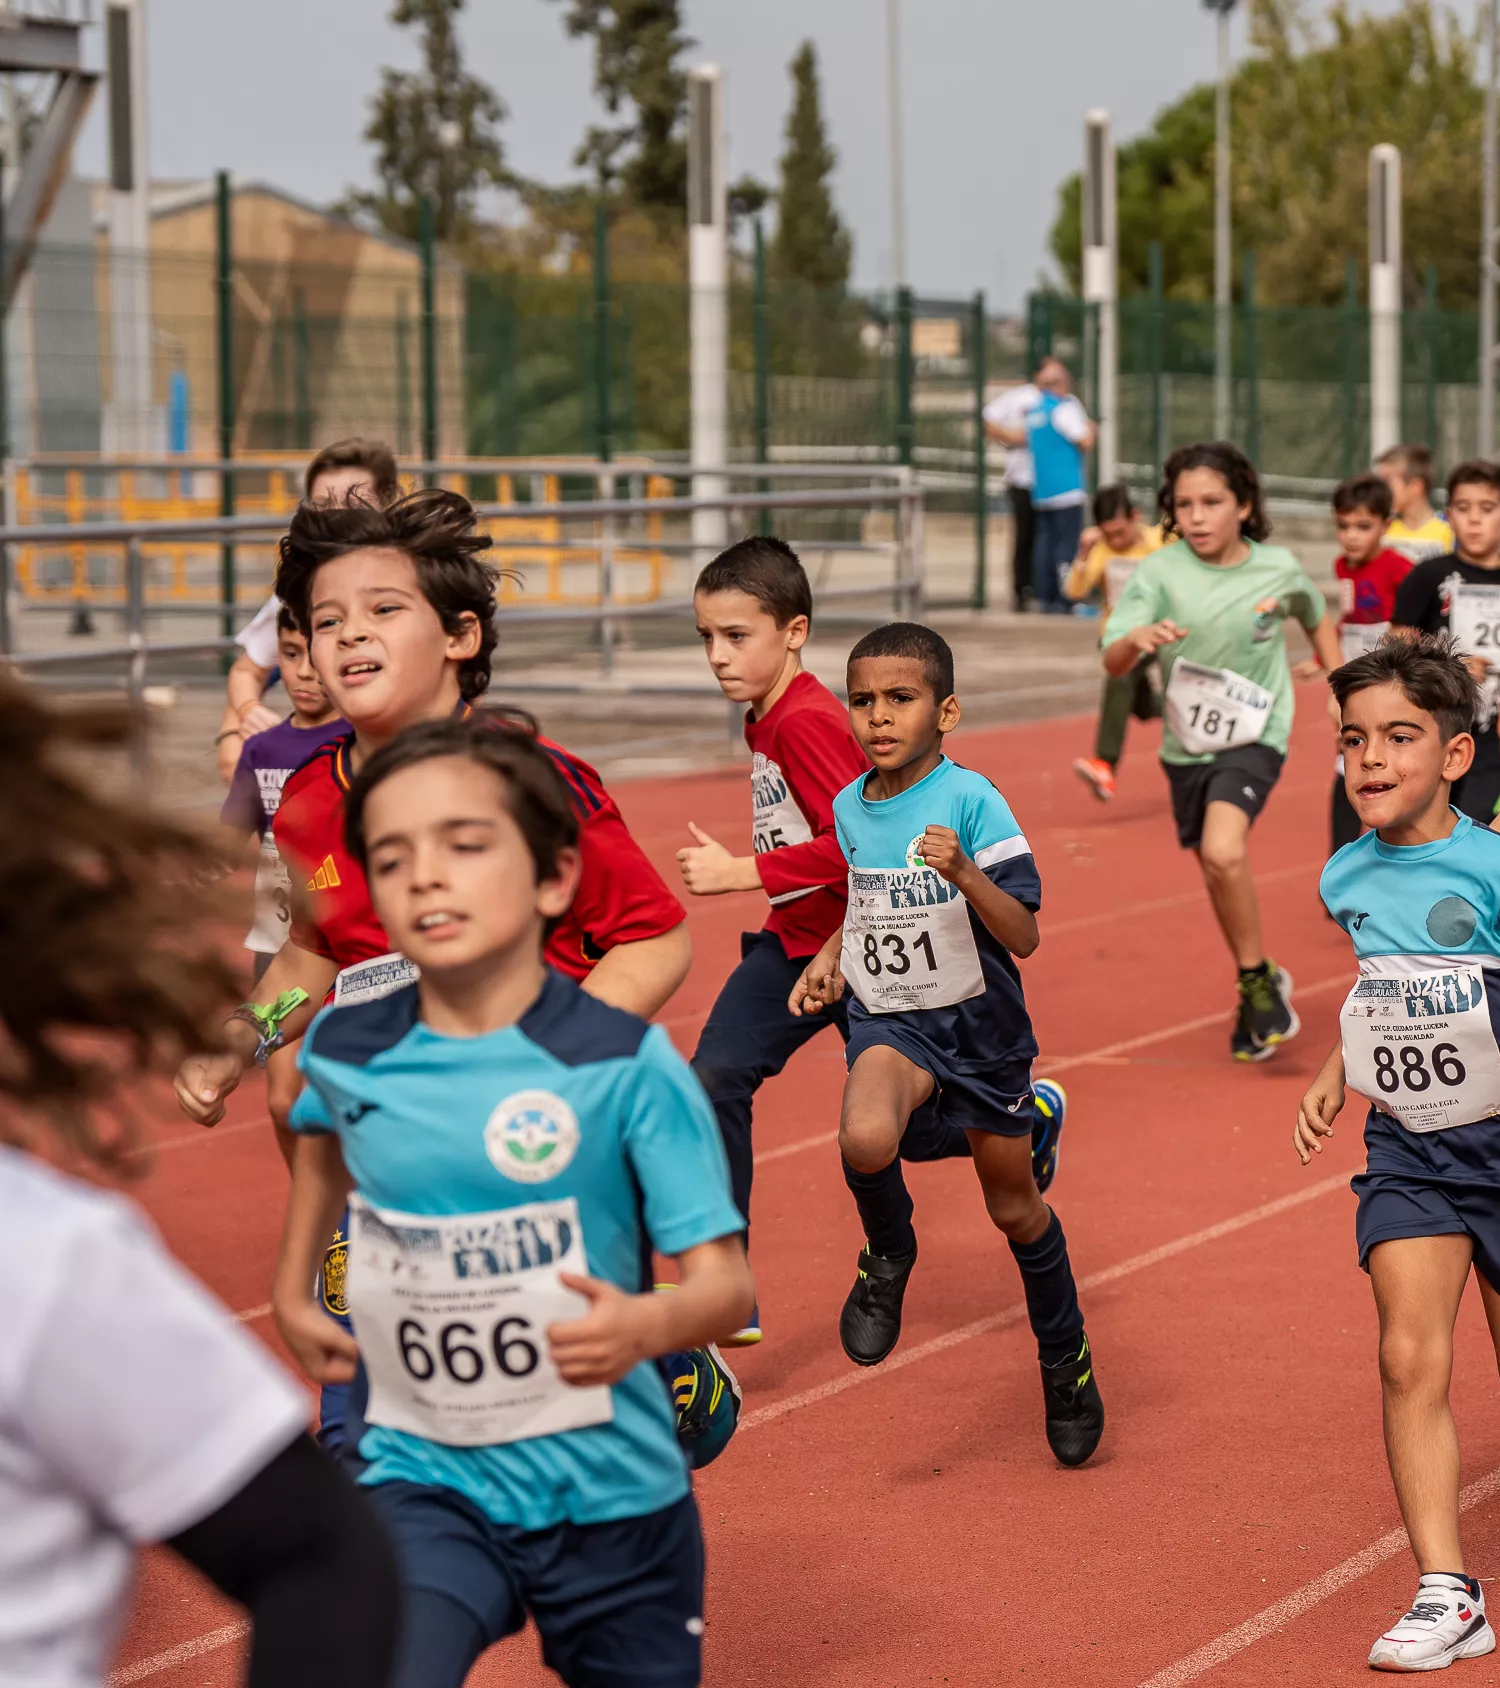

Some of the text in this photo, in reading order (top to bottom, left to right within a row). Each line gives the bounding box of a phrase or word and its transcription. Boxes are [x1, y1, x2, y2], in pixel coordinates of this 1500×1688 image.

[1189, 703, 1238, 742] 181
[886, 871, 926, 891] 2024
[905, 912, 930, 920] LUCENA
[863, 930, 938, 977] 831
[371, 967, 415, 986] POPULARES
[1392, 980, 1400, 988] DE
[1401, 976, 1446, 998] 2024
[1392, 1024, 1413, 1032] CIUDAD
[1423, 1022, 1449, 1031] LUCENA
[1403, 1033, 1435, 1041] IGUALDAD
[1373, 1042, 1466, 1093] 886
[1439, 1098, 1460, 1107] EGEA
[396, 1316, 539, 1384] 666
